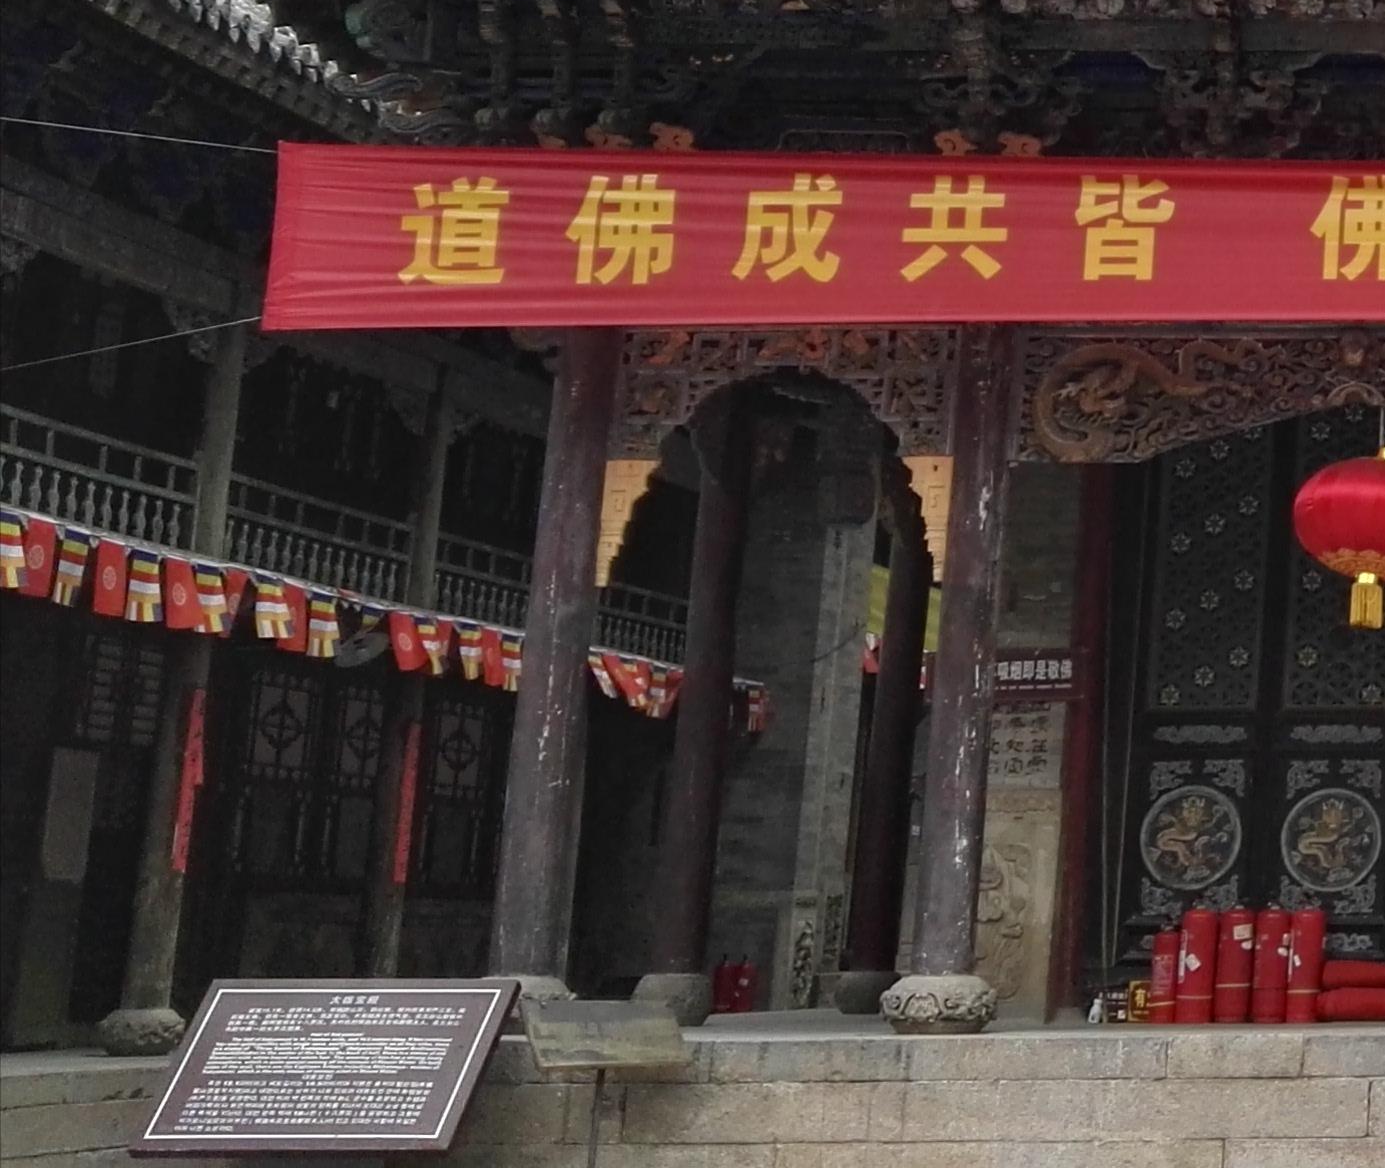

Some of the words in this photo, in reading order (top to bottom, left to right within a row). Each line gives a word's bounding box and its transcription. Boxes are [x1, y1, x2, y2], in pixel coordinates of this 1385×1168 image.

[995, 659, 1072, 680] 吸烟即是敬佛
